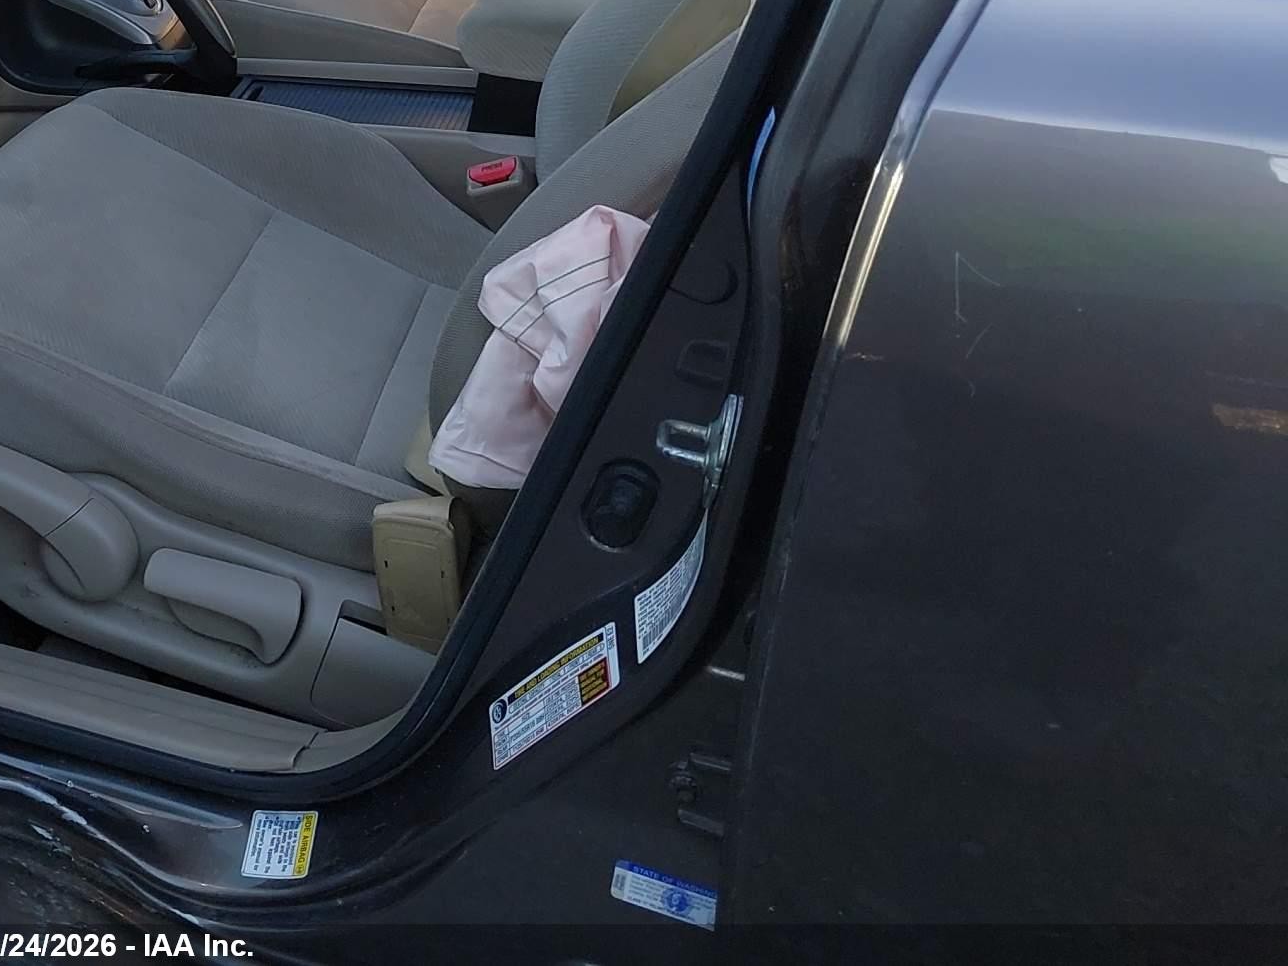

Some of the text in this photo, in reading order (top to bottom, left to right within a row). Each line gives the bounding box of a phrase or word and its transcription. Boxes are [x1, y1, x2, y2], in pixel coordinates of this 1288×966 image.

[560, 636, 598, 666] INFORMATION
[297, 815, 312, 863] SIDE AIRBAG
[632, 866, 660, 880] STATE
[662, 875, 673, 883] OF
